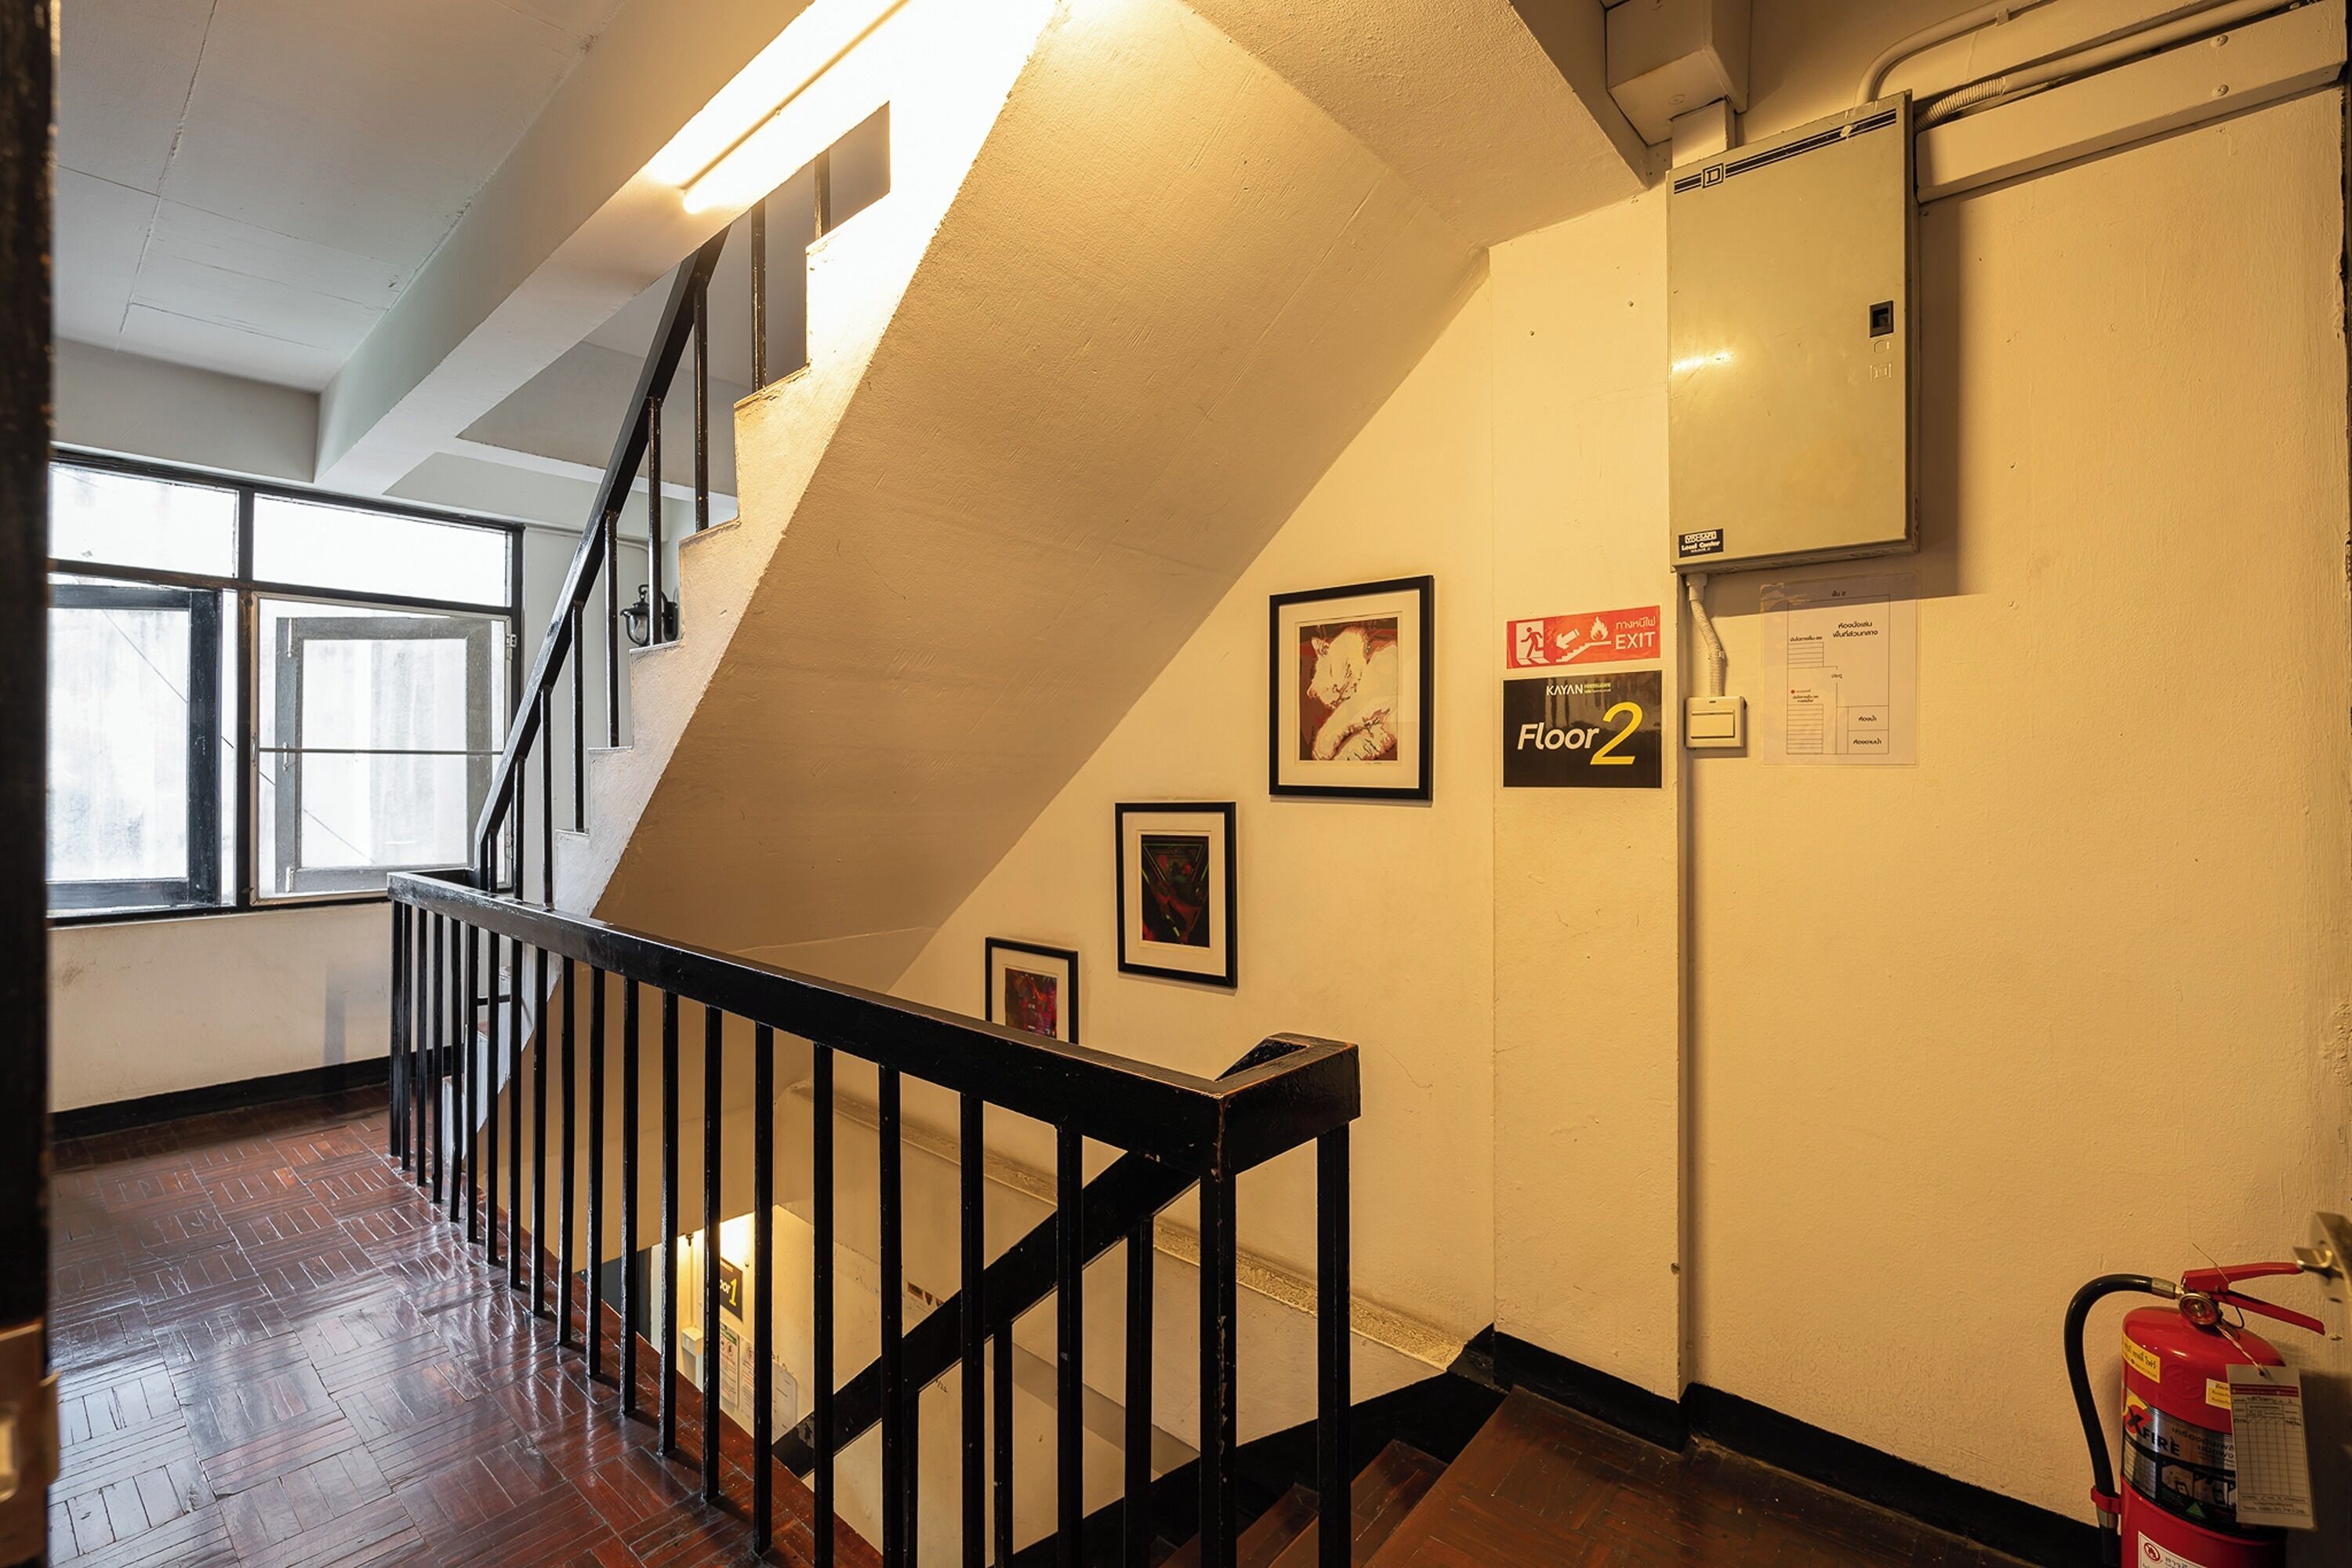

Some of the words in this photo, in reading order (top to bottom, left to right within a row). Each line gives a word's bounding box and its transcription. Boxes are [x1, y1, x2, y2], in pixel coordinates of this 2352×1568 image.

[1616, 616, 1656, 630] ทางหนีไฟ
[1615, 631, 1656, 650] EXIT
[1546, 684, 1583, 696] KAYAN
[1517, 722, 1599, 750] Floor
[1590, 701, 1643, 766] 2
[728, 1277, 738, 1308] 1
